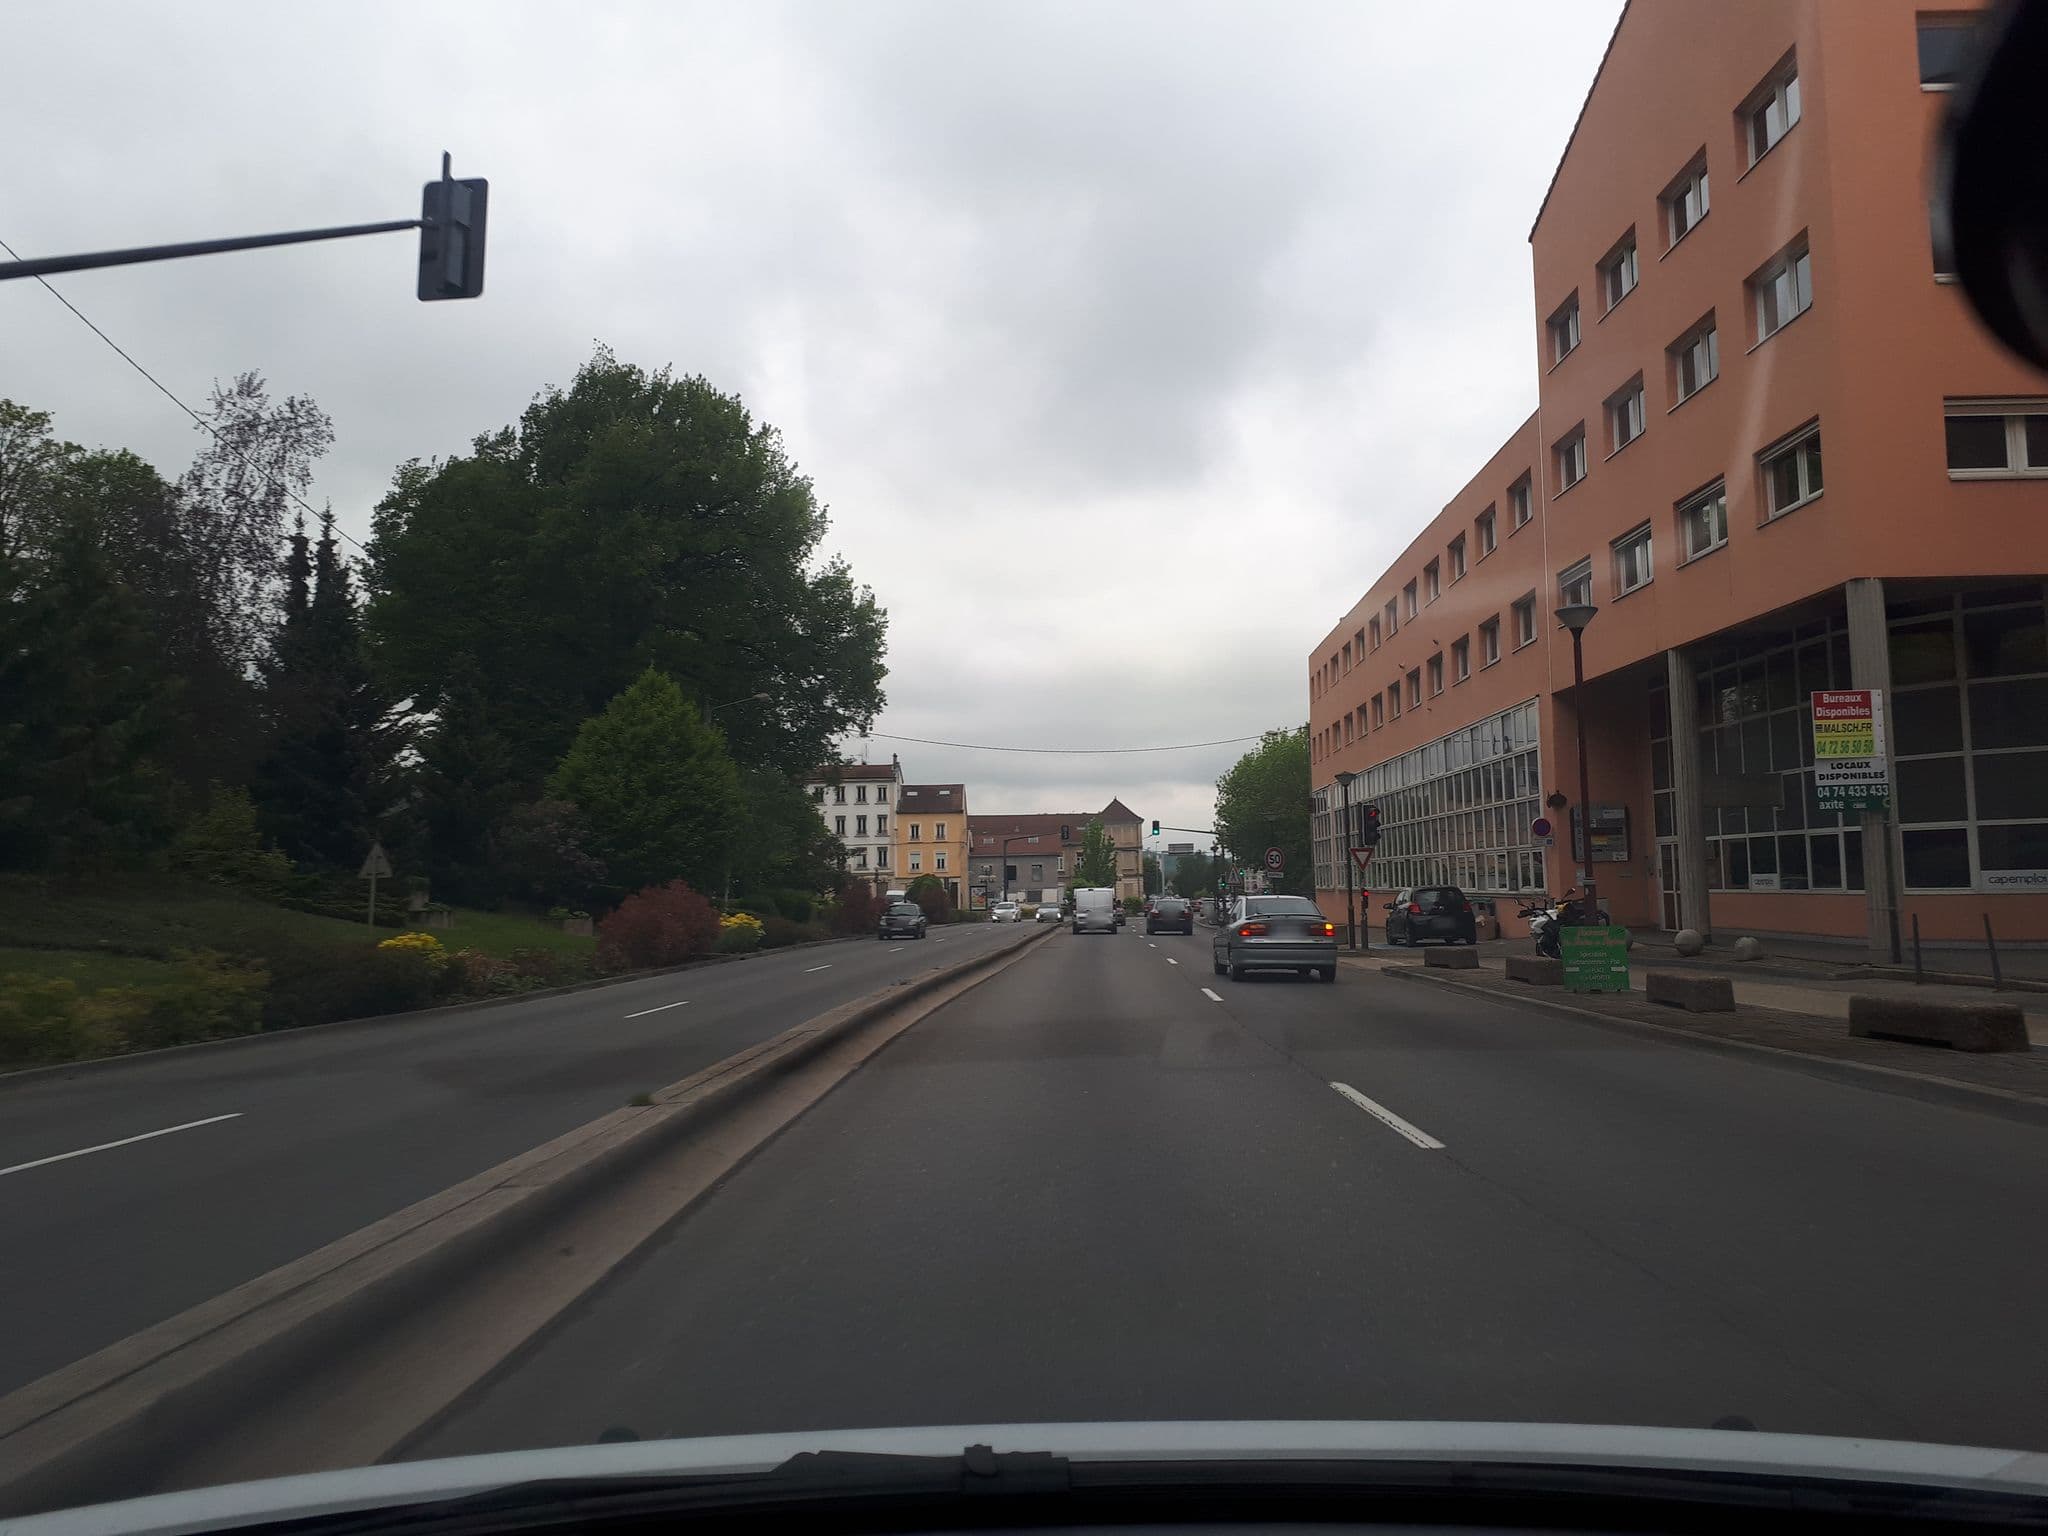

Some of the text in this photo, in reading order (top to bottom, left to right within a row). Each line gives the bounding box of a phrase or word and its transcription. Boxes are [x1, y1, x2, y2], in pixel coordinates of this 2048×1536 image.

[1823, 694, 1862, 703] Bureaux
[1816, 707, 1870, 718] Disponibles
[1824, 723, 1872, 733] MALSCH.FR
[1816, 741, 1826, 754] 04
[1829, 740, 1838, 753] 72
[1830, 762, 1871, 770] LOCAUX
[1818, 772, 1885, 780] DISPONIBLES
[1817, 785, 1889, 798] 04 74 433 433
[1818, 800, 1845, 810] axite
[1269, 855, 1280, 864] 50
